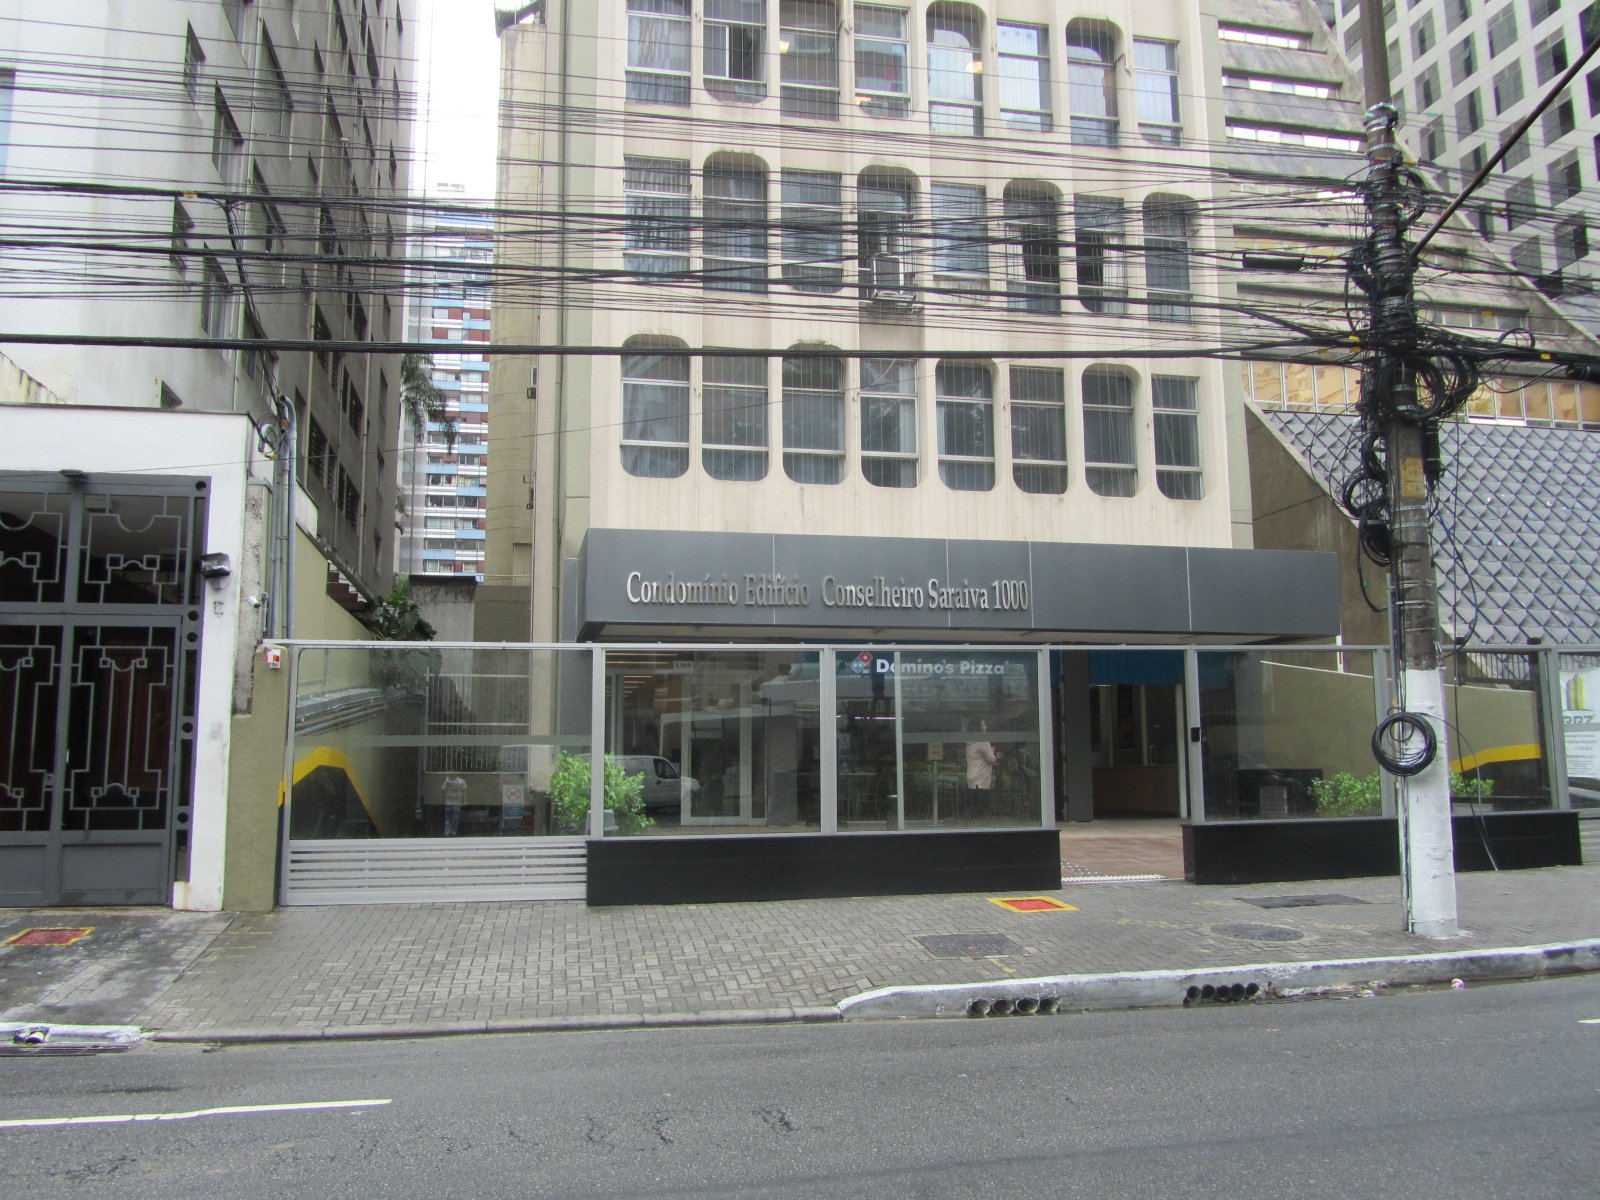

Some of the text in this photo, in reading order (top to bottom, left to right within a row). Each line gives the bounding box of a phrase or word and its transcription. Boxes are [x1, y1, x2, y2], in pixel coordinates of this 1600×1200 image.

[626, 570, 1029, 610] Condomínio Edifício Conselheiro Saraiva 1000
[960, 660, 1005, 675] Pizza
